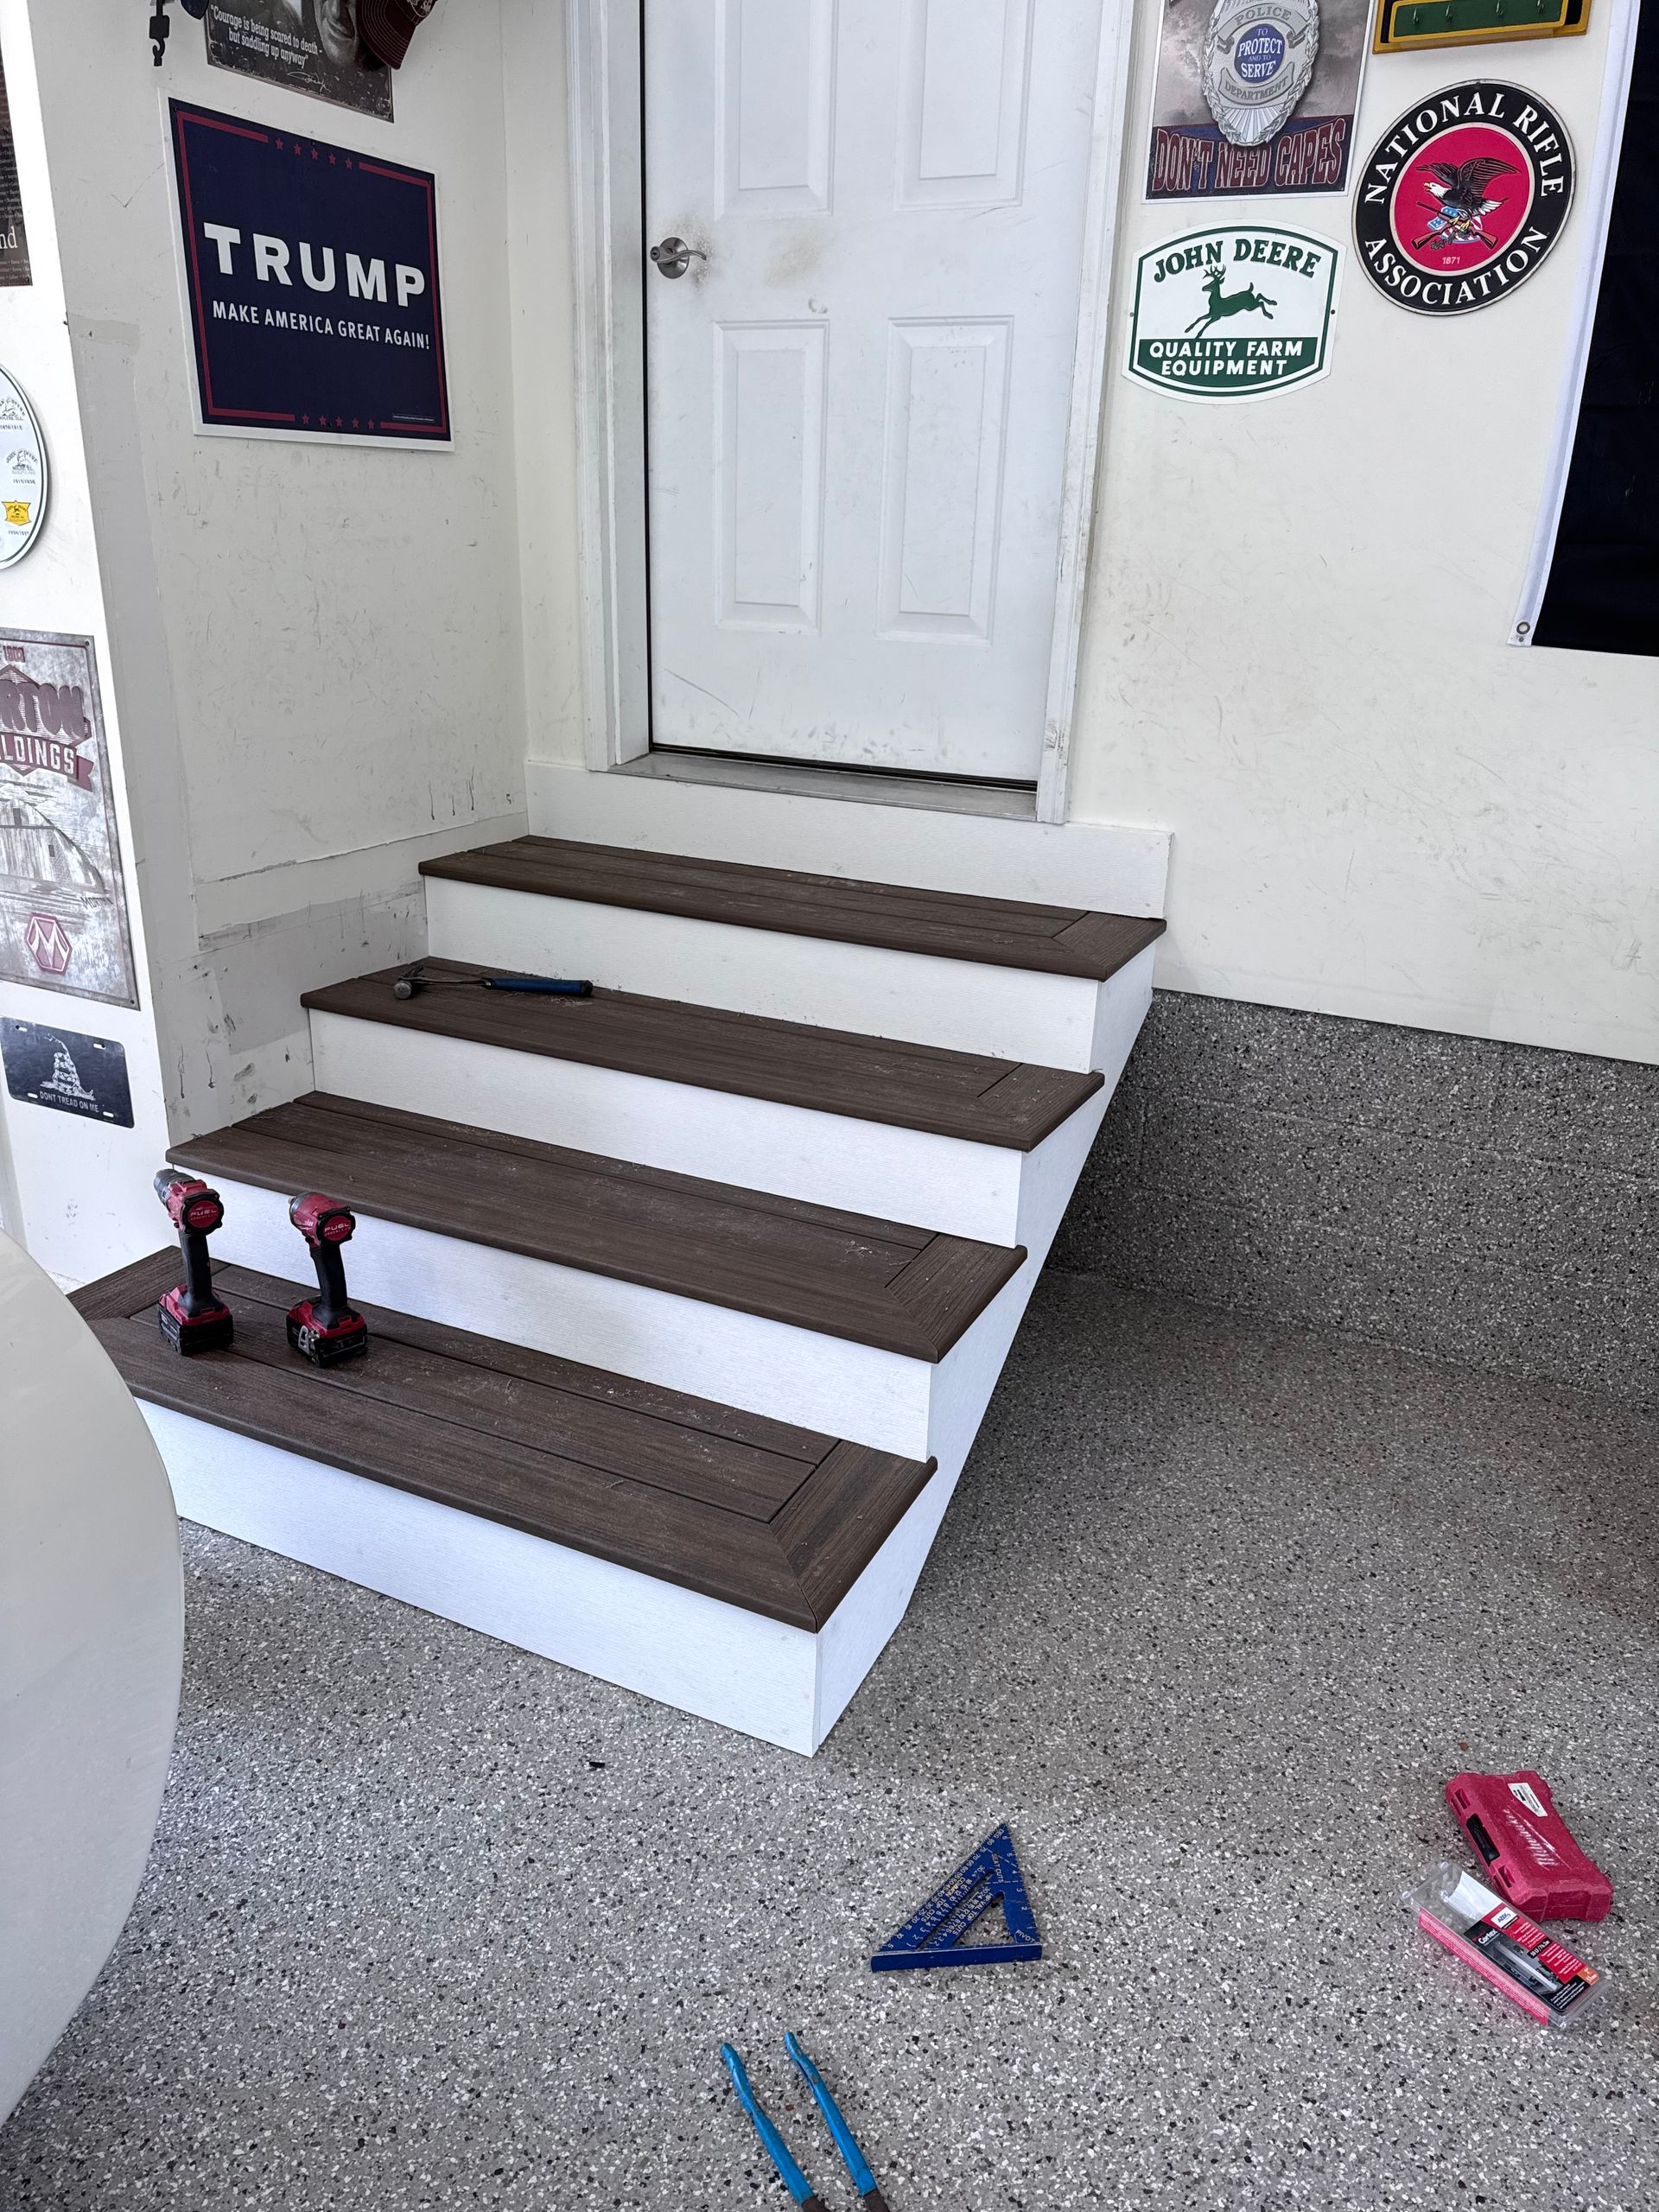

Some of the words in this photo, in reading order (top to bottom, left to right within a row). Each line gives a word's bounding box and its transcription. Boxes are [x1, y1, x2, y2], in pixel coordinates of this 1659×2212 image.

[1235, 6, 1291, 25] POLICE
[244, 16, 249, 29] is
[251, 19, 269, 41] being
[270, 29, 291, 46] scared
[293, 35, 299, 50] to
[301, 38, 318, 54] death
[1257, 28, 1268, 36] TO
[229, 28, 240, 42] but
[241, 34, 269, 57] saddling
[271, 47, 279, 60] up
[1237, 38, 1282, 58] PROTECT
[1241, 60, 1276, 78] SERVE
[1225, 76, 1287, 101] DEPARTMENT
[1152, 128, 1214, 191] DON'T
[1215, 142, 1272, 188] NEED
[1274, 118, 1345, 187] CAPES
[1364, 92, 1505, 204] NATIONAL
[1513, 105, 1564, 197] RIFLE
[204, 222, 425, 307] TRUMP
[1154, 241, 1224, 283] JOHN
[1233, 238, 1322, 278] DEERE
[1365, 227, 1548, 305] ASSOCIATION
[1442, 256, 1460, 264] 1871
[213, 300, 259, 324] MAKE
[264, 308, 334, 335] AMERICA
[338, 321, 380, 342] GREAT
[385, 327, 429, 349] AGAIN!
[1149, 341, 1237, 358] QUALITY
[1247, 341, 1303, 356] FARM
[1161, 359, 1287, 376] EQUIPMENT
[0, 734, 75, 775] LDINGS
[40, 1091, 57, 1103] DONT
[57, 1095, 78, 1108] TREAD
[79, 1101, 89, 1110] ON
[90, 1103, 99, 1112] ME
[191, 1209, 216, 1217] FUEL
[324, 1223, 349, 1232] FUEL
[936, 1897, 946, 1908] TOP
[921, 1909, 935, 1922] CUTS
[967, 1908, 977, 1920] TOP
[952, 1922, 966, 1935] CUTS
[1015, 1929, 1035, 1943] PIVOT
[1478, 1928, 1498, 1944] Cortex
